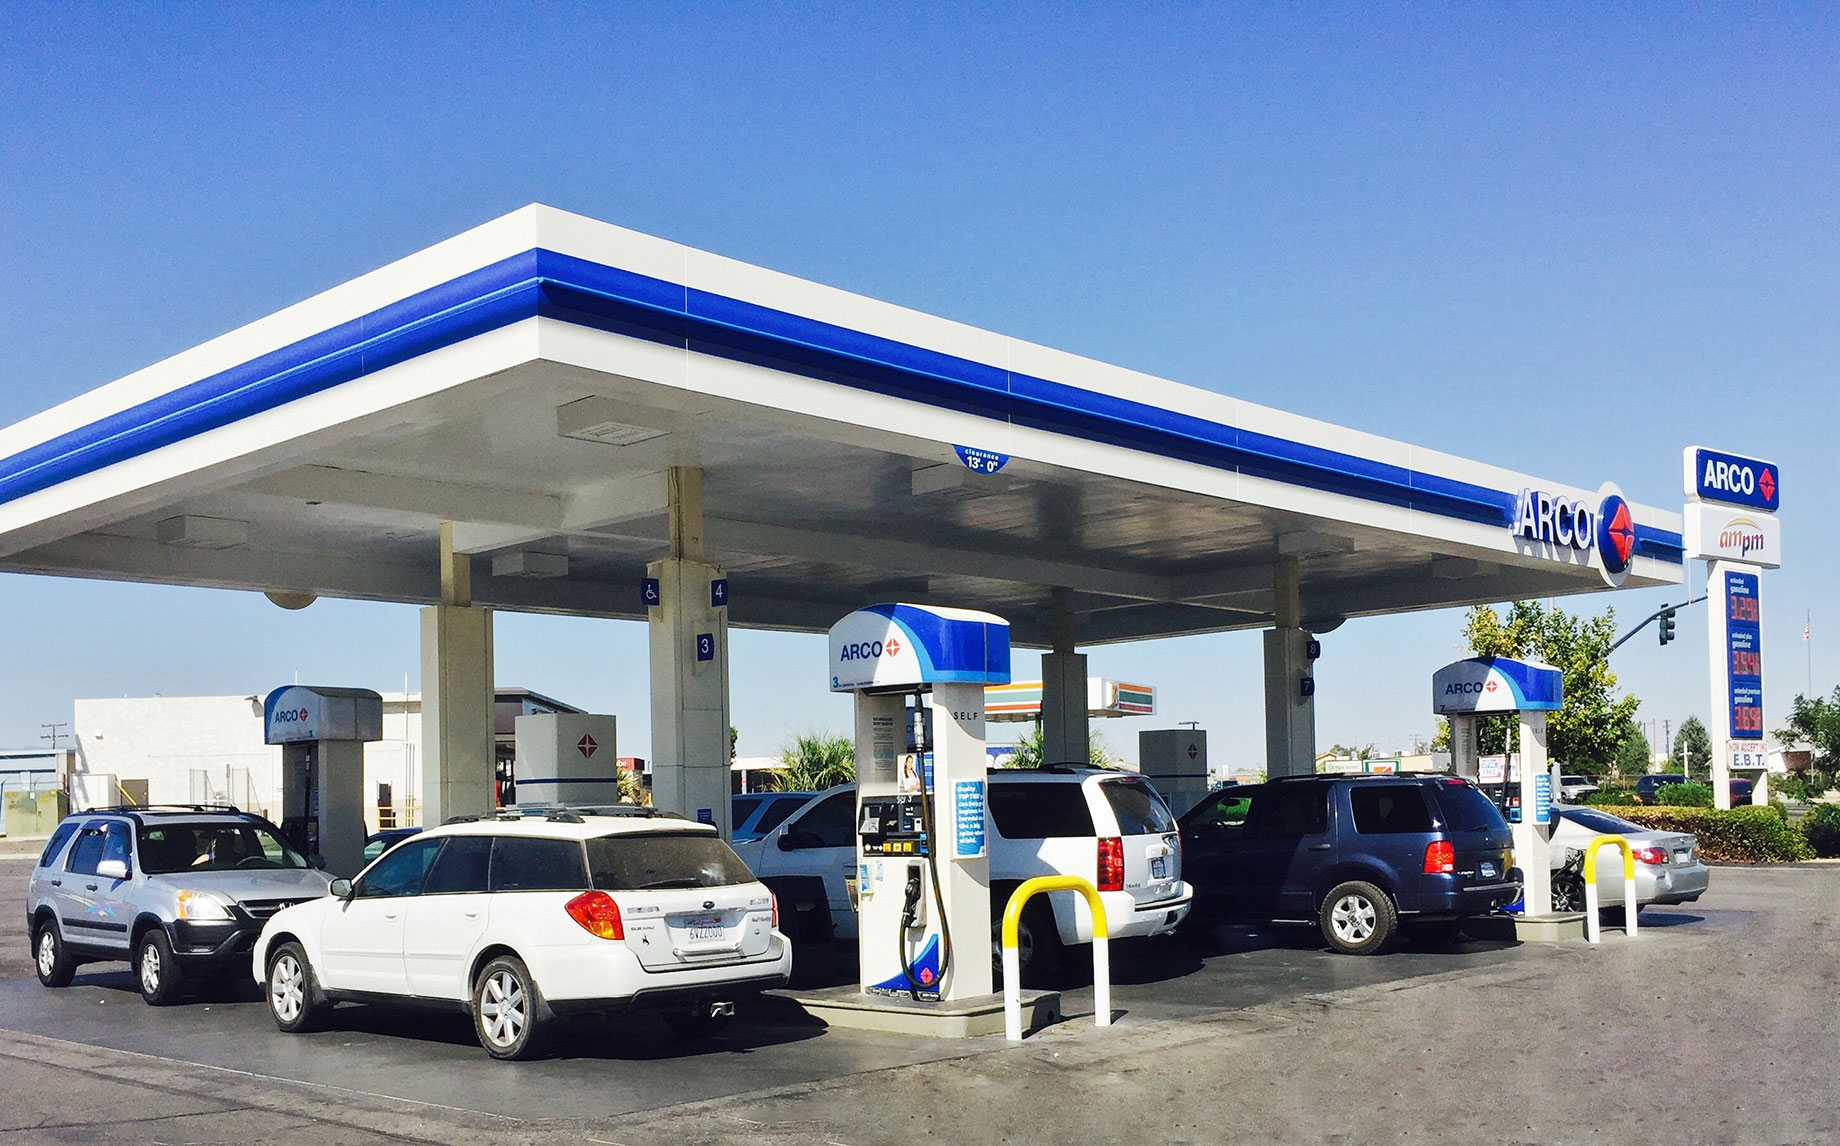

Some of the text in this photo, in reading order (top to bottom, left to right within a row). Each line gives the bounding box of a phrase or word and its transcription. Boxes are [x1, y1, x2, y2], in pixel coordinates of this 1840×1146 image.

[965, 449, 999, 460] clearance
[1704, 459, 1754, 495] ARCO
[1517, 488, 1591, 549] ARCO
[1720, 530, 1764, 557] ampm
[715, 583, 723, 598] 4
[1730, 585, 1750, 594] gasoline
[701, 638, 709, 653] 3
[841, 640, 883, 661] ARCO
[1310, 643, 1316, 654] 8
[1732, 640, 1751, 649] gasoline
[833, 676, 839, 688] 3
[1304, 681, 1310, 691] 7
[1445, 682, 1484, 695] ARCO
[1735, 695, 1753, 704] gasoline
[275, 709, 298, 723] ARCO
[953, 711, 978, 720] SELF
[1733, 753, 1765, 766] E.B.T.
